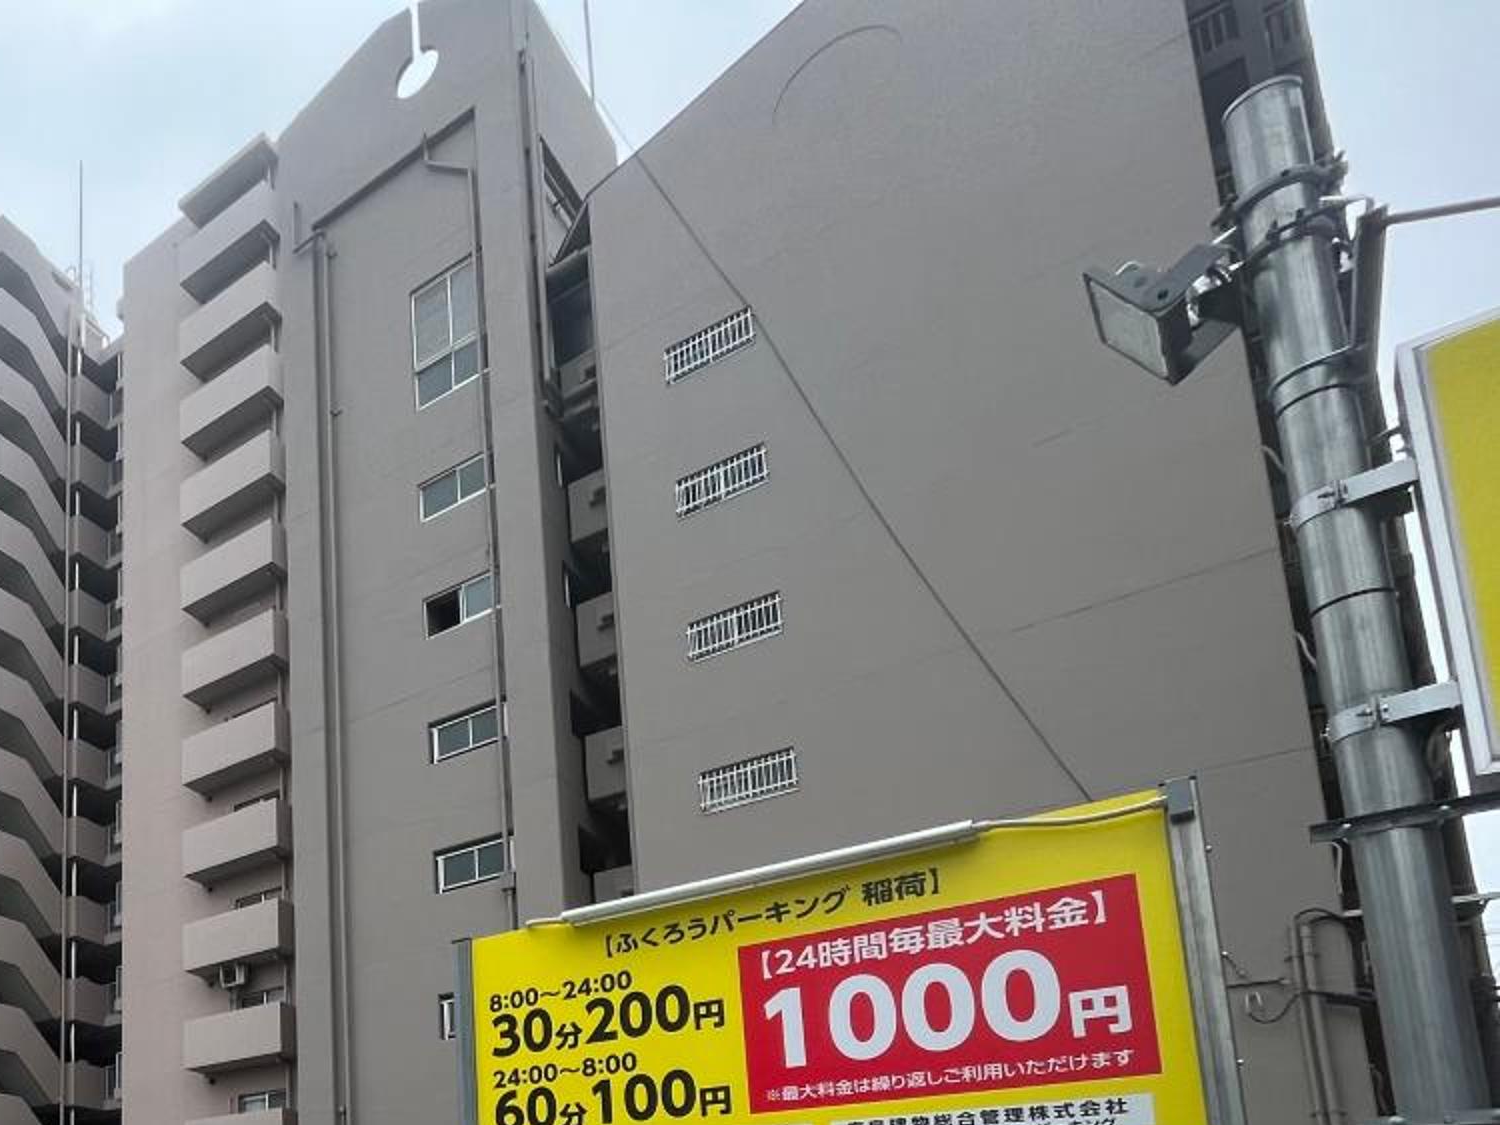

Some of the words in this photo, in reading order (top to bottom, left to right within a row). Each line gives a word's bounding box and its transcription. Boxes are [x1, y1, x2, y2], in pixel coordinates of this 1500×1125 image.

[605, 883, 851, 957] 【ふくろうパーキング
[862, 867, 939, 906] 稲荷】
[762, 890, 1106, 979] 【24時間毎最大料金】
[492, 985, 724, 1057] 30分200円
[764, 949, 1133, 1068] 1000円
